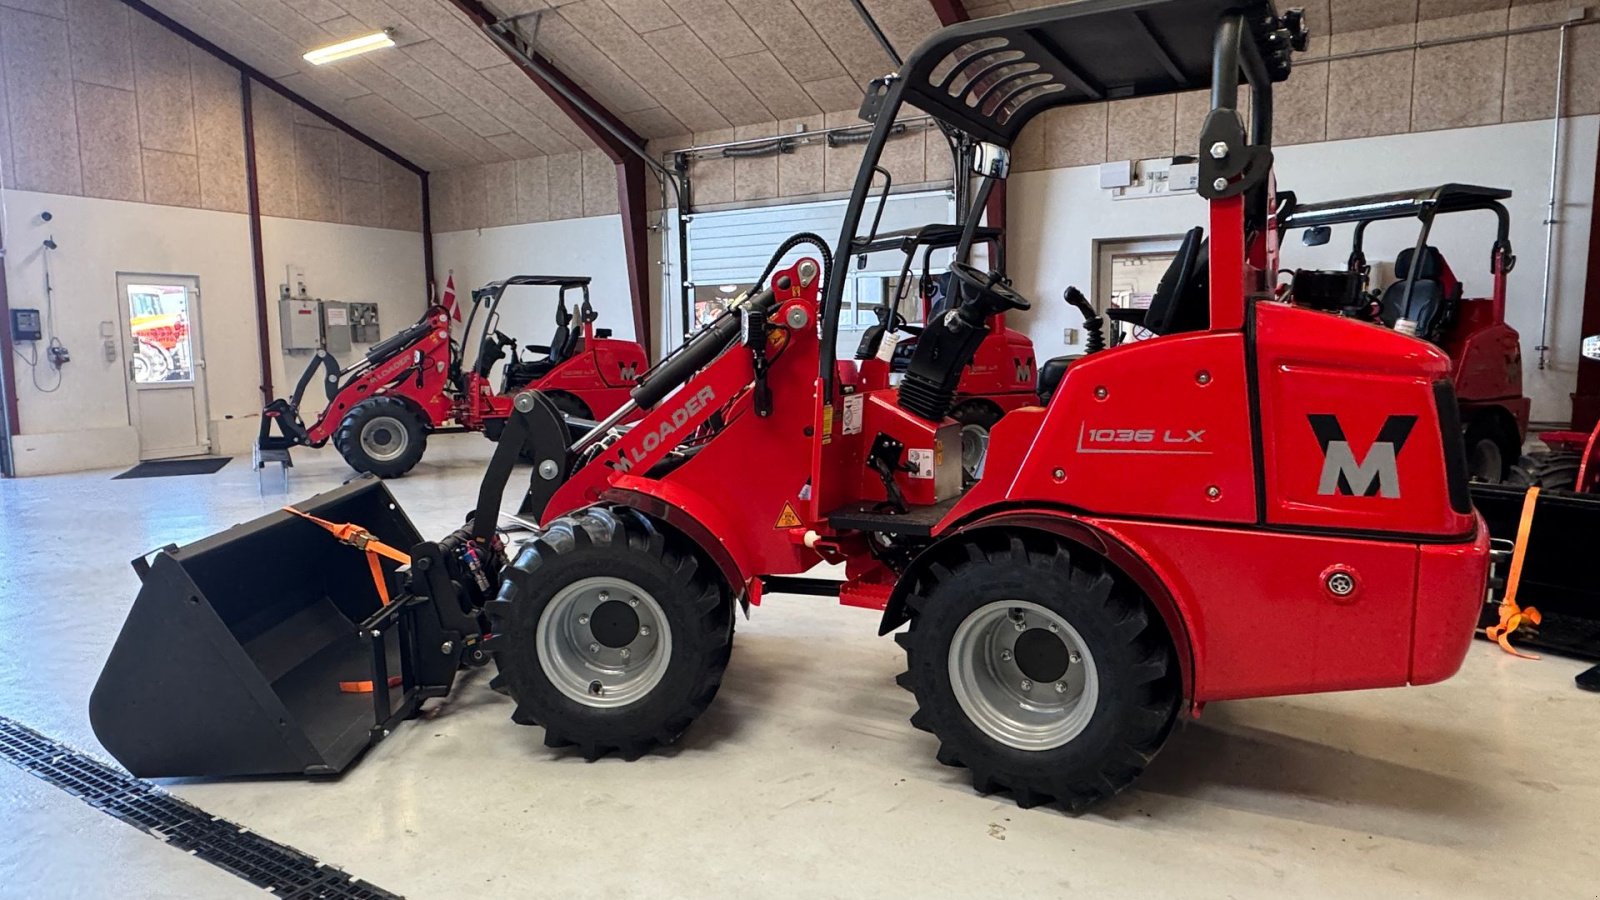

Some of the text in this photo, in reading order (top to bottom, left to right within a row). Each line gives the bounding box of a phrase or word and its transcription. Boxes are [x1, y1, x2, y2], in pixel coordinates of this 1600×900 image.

[630, 385, 716, 463] LOADER
[1088, 428, 1206, 443] 1036 LX
